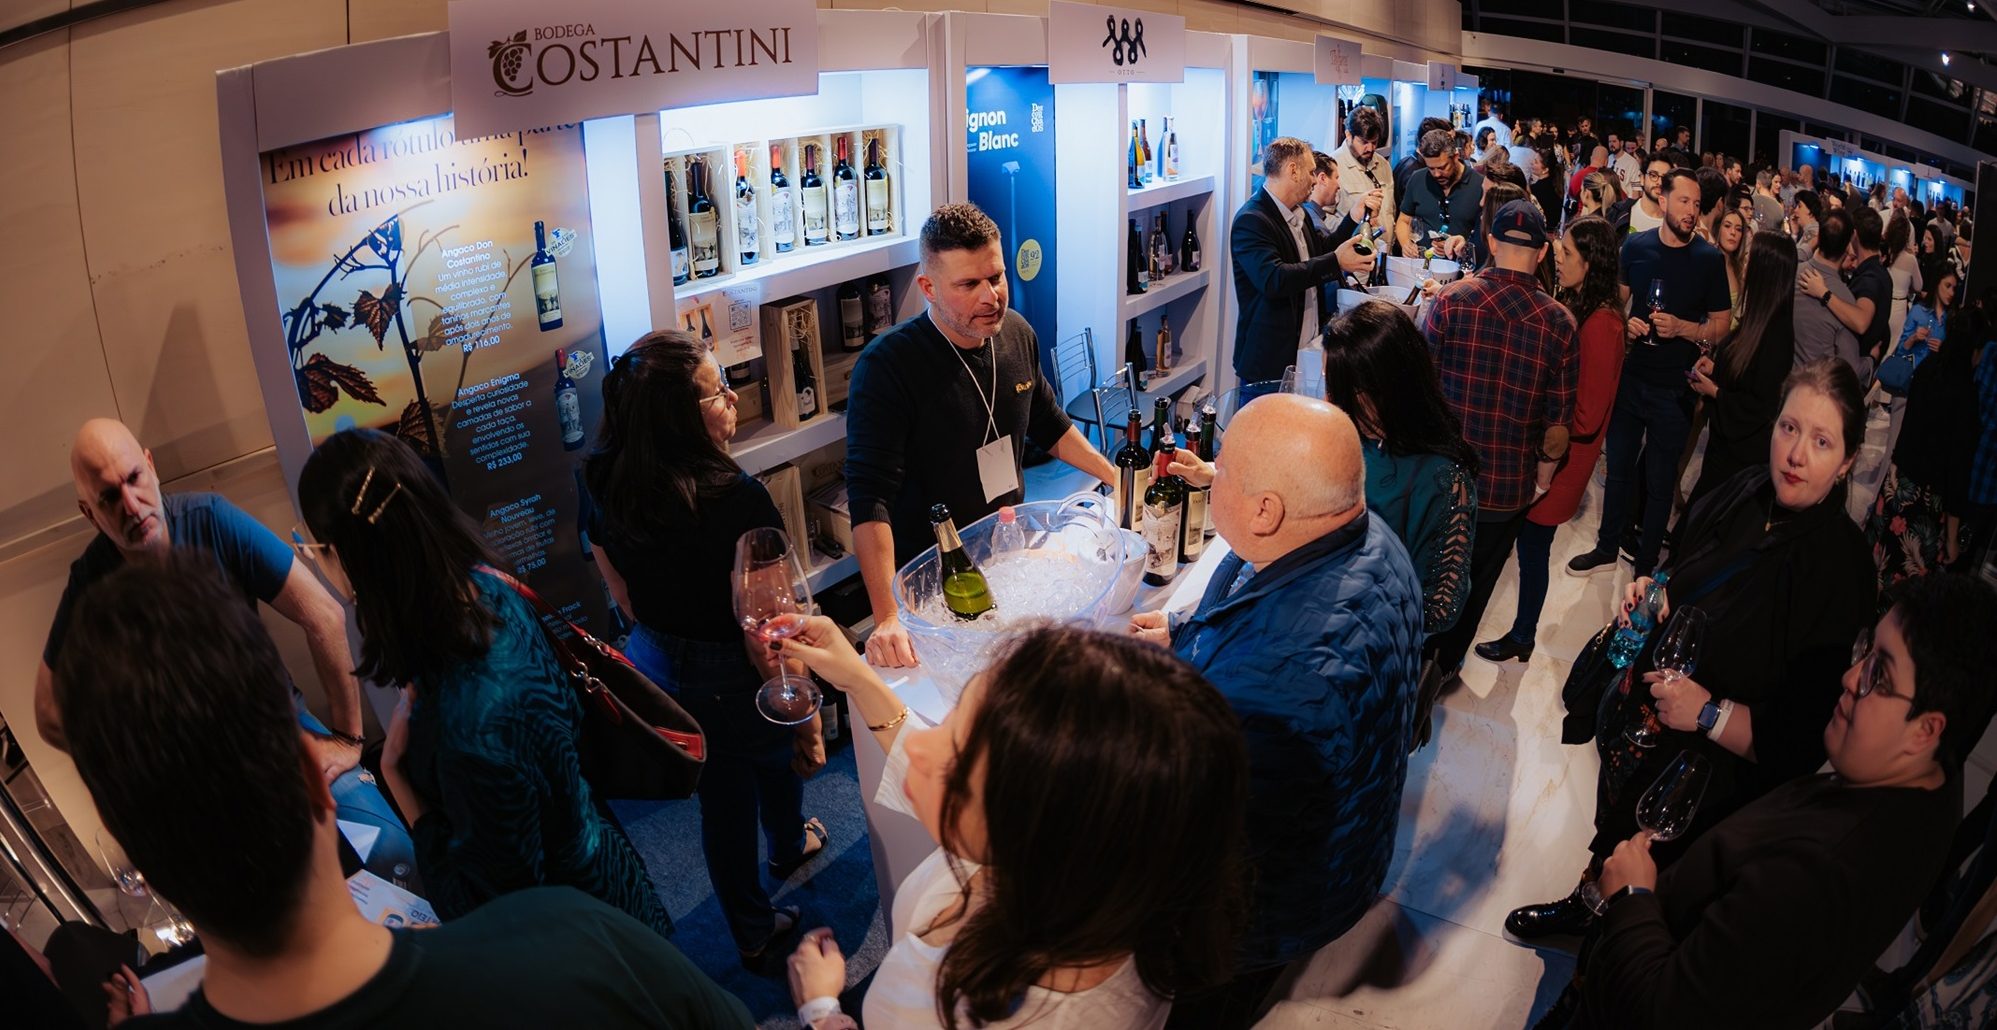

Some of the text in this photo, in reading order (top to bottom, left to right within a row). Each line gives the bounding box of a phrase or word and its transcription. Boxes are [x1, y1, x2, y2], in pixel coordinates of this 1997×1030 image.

[534, 24, 596, 41] BODEGA
[492, 27, 793, 96] COSTANTINI
[979, 130, 1019, 152] Blanc
[270, 151, 314, 184] Em
[319, 132, 377, 172] cada
[328, 149, 529, 217] da nossa história!
[441, 240, 493, 258] Angaco Don
[438, 260, 502, 281] Um vinho rubi de
[447, 252, 491, 268] Costantino
[450, 286, 488, 301] complexo
[489, 292, 507, 302] com
[442, 302, 511, 325] taninos marcantes
[444, 312, 511, 337] após dois anos de
[463, 344, 473, 353] R$
[452, 380, 528, 410] Desperta curiosidade
[458, 372, 520, 397] Angaco Enigma
[473, 401, 496, 414] revela
[497, 394, 518, 404] novas
[456, 412, 492, 428] camadas
[493, 408, 504, 418] de
[504, 402, 524, 413] sabor
[472, 422, 524, 444] envolvendo os
[476, 422, 496, 432] cada
[470, 430, 531, 455] sentidos com sua
[486, 452, 522, 471] R$ 233,00
[490, 494, 542, 518] Angaco Syrah
[500, 508, 535, 524] Nouveau
[540, 519, 556, 528] com
[527, 558, 546, 570] 75,00
